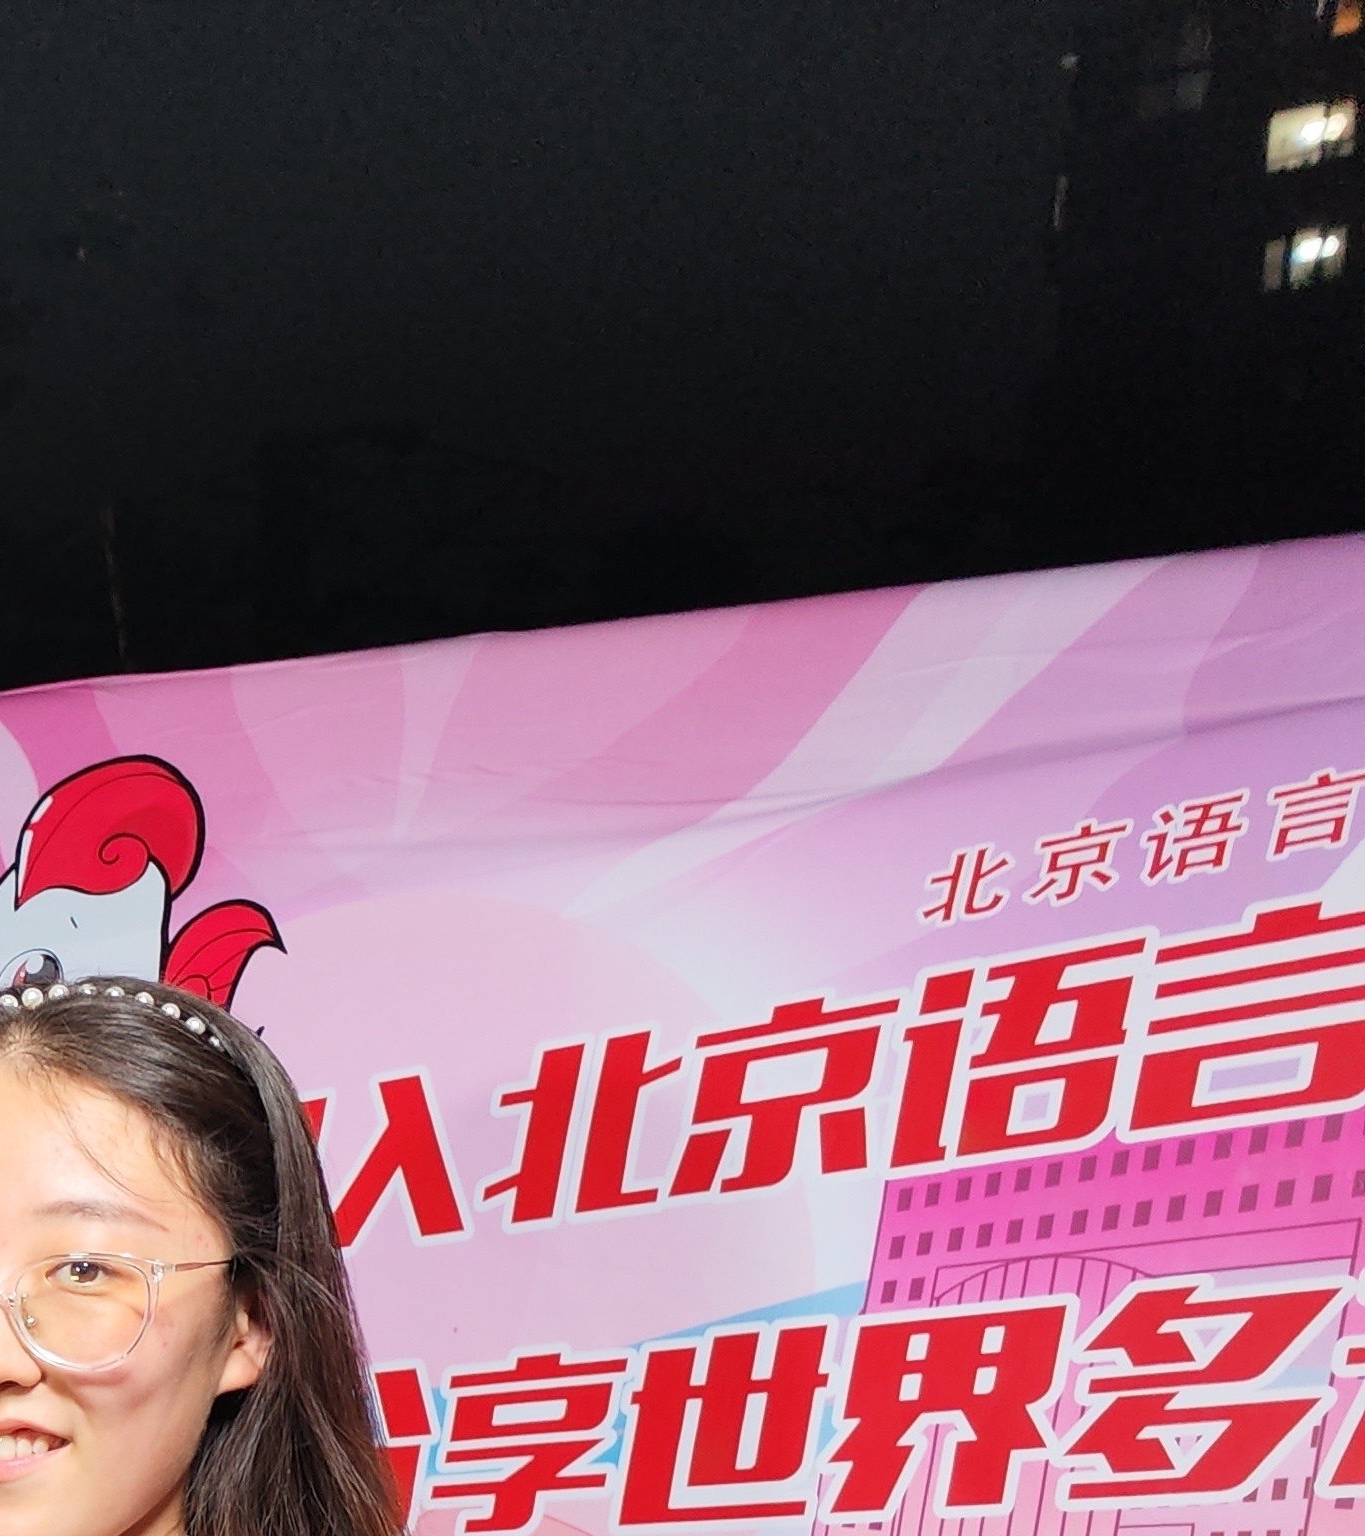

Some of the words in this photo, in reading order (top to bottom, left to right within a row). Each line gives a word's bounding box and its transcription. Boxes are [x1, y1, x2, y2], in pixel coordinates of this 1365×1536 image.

[921, 774, 1365, 924] 北京语言
[299, 902, 1365, 1250] 入北京语言
[372, 1285, 1365, 1533] 享世界多
